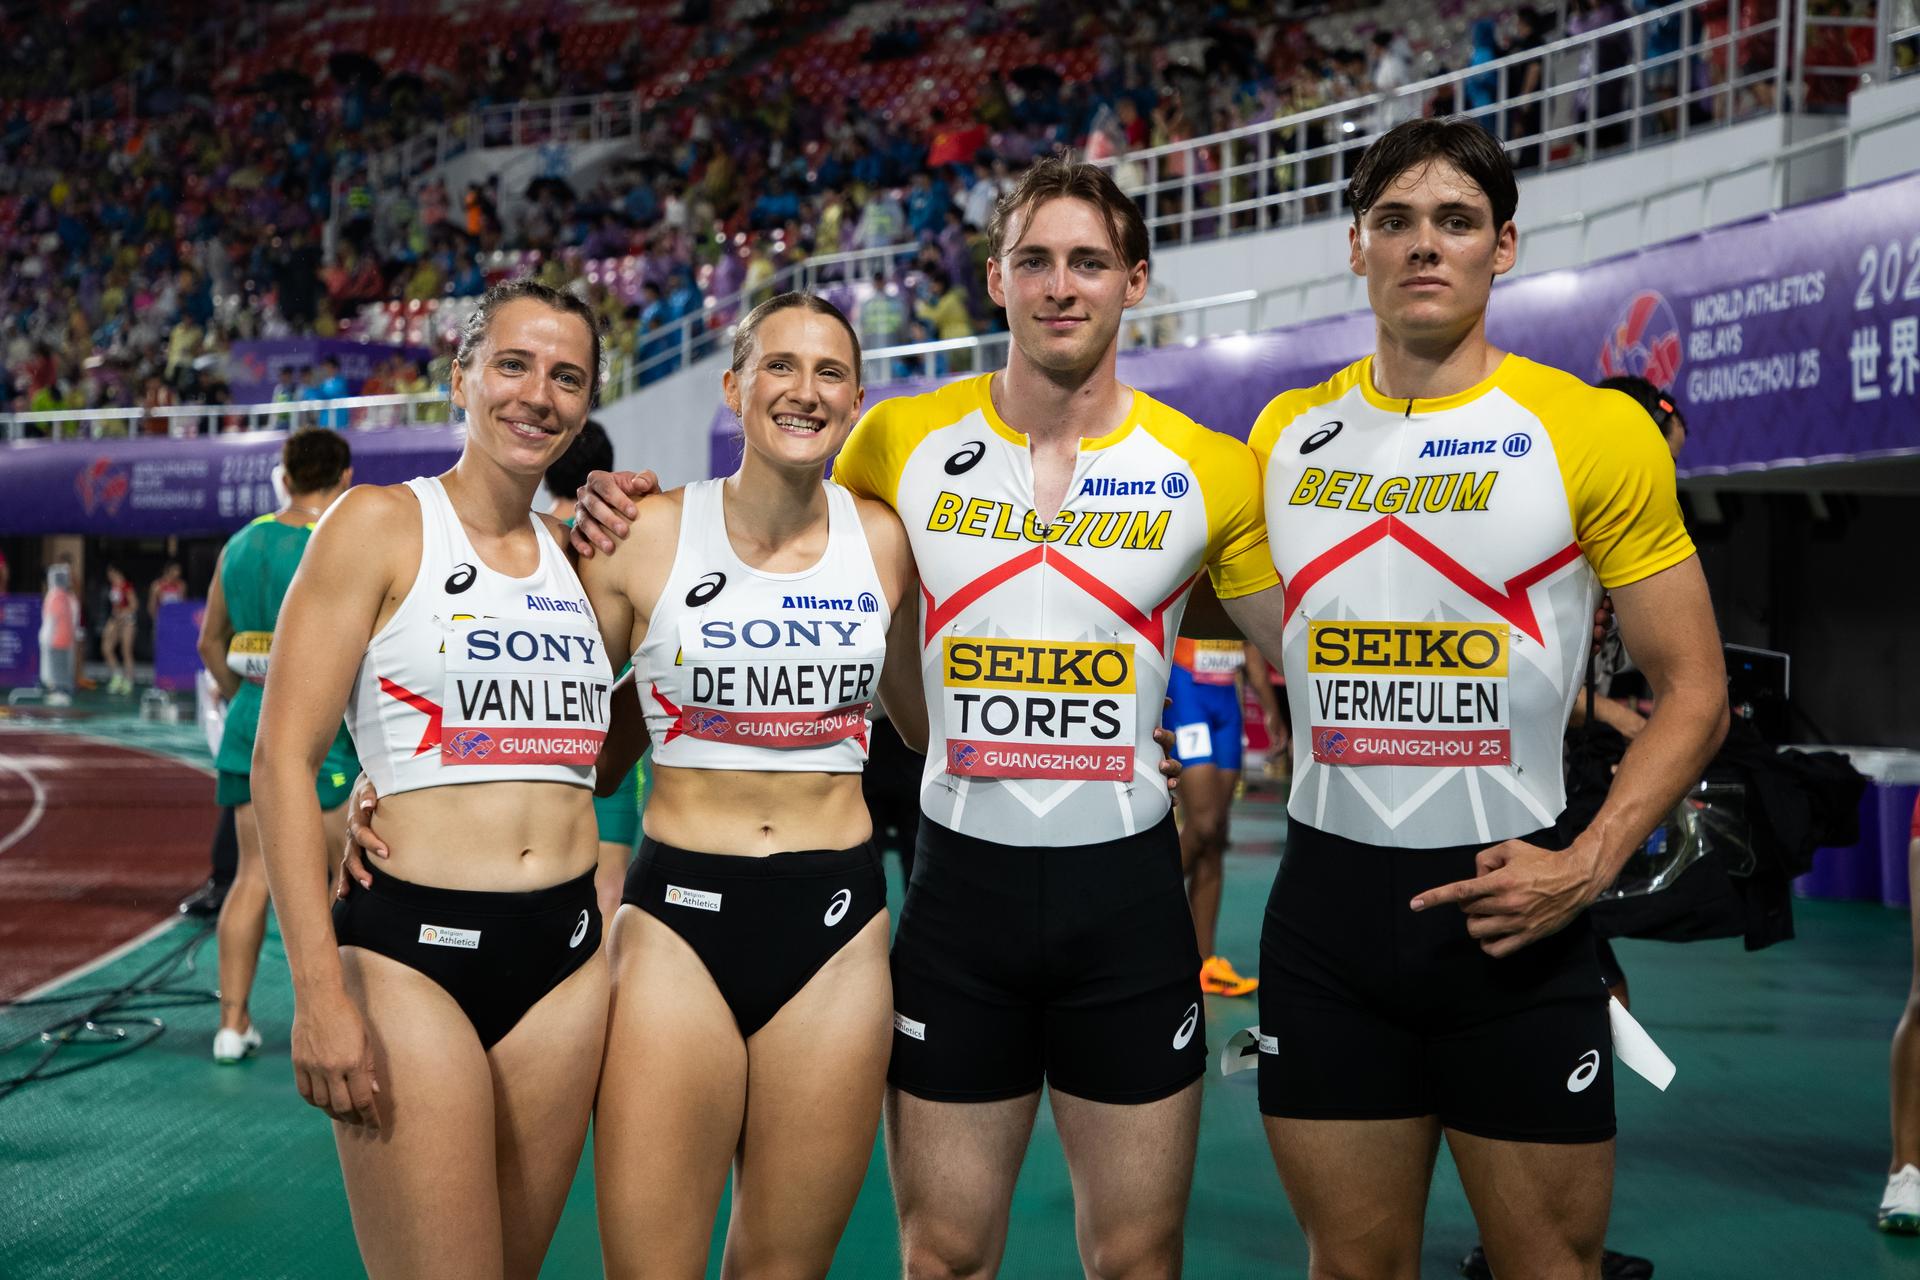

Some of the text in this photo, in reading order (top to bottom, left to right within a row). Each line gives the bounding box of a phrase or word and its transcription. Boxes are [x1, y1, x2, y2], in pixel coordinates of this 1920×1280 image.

[1692, 270, 1826, 327] WORLD ATHLETICS
[1689, 324, 1743, 361] RELAYS
[1687, 347, 1821, 403] GUANGZHOU 25
[1418, 439, 1498, 459] Allianz
[1079, 477, 1157, 497] Allianz
[1288, 466, 1499, 515] BELGIUM
[926, 490, 1173, 551] BELGIUM
[526, 594, 581, 614] Allianz
[782, 595, 855, 612] Allianz
[467, 629, 595, 664] SONY
[700, 619, 861, 649] SONY
[1314, 626, 1500, 670] SEIKO
[949, 642, 1129, 688] SEIKO
[692, 663, 875, 707] DE NAEYER
[457, 679, 607, 724] VAN LENT
[953, 693, 1121, 740] TORFS
[1315, 679, 1500, 724] VERMEULEN
[736, 715, 843, 738] GUANGZHOU
[1187, 731, 1199, 752] 7
[499, 736, 598, 756] GUANGZHOU
[983, 750, 1126, 771] GUANGZHOU 25
[1353, 738, 1501, 757] GUANGZHOU 25
[682, 897, 718, 909] Athletics
[439, 936, 476, 947] Athletics
